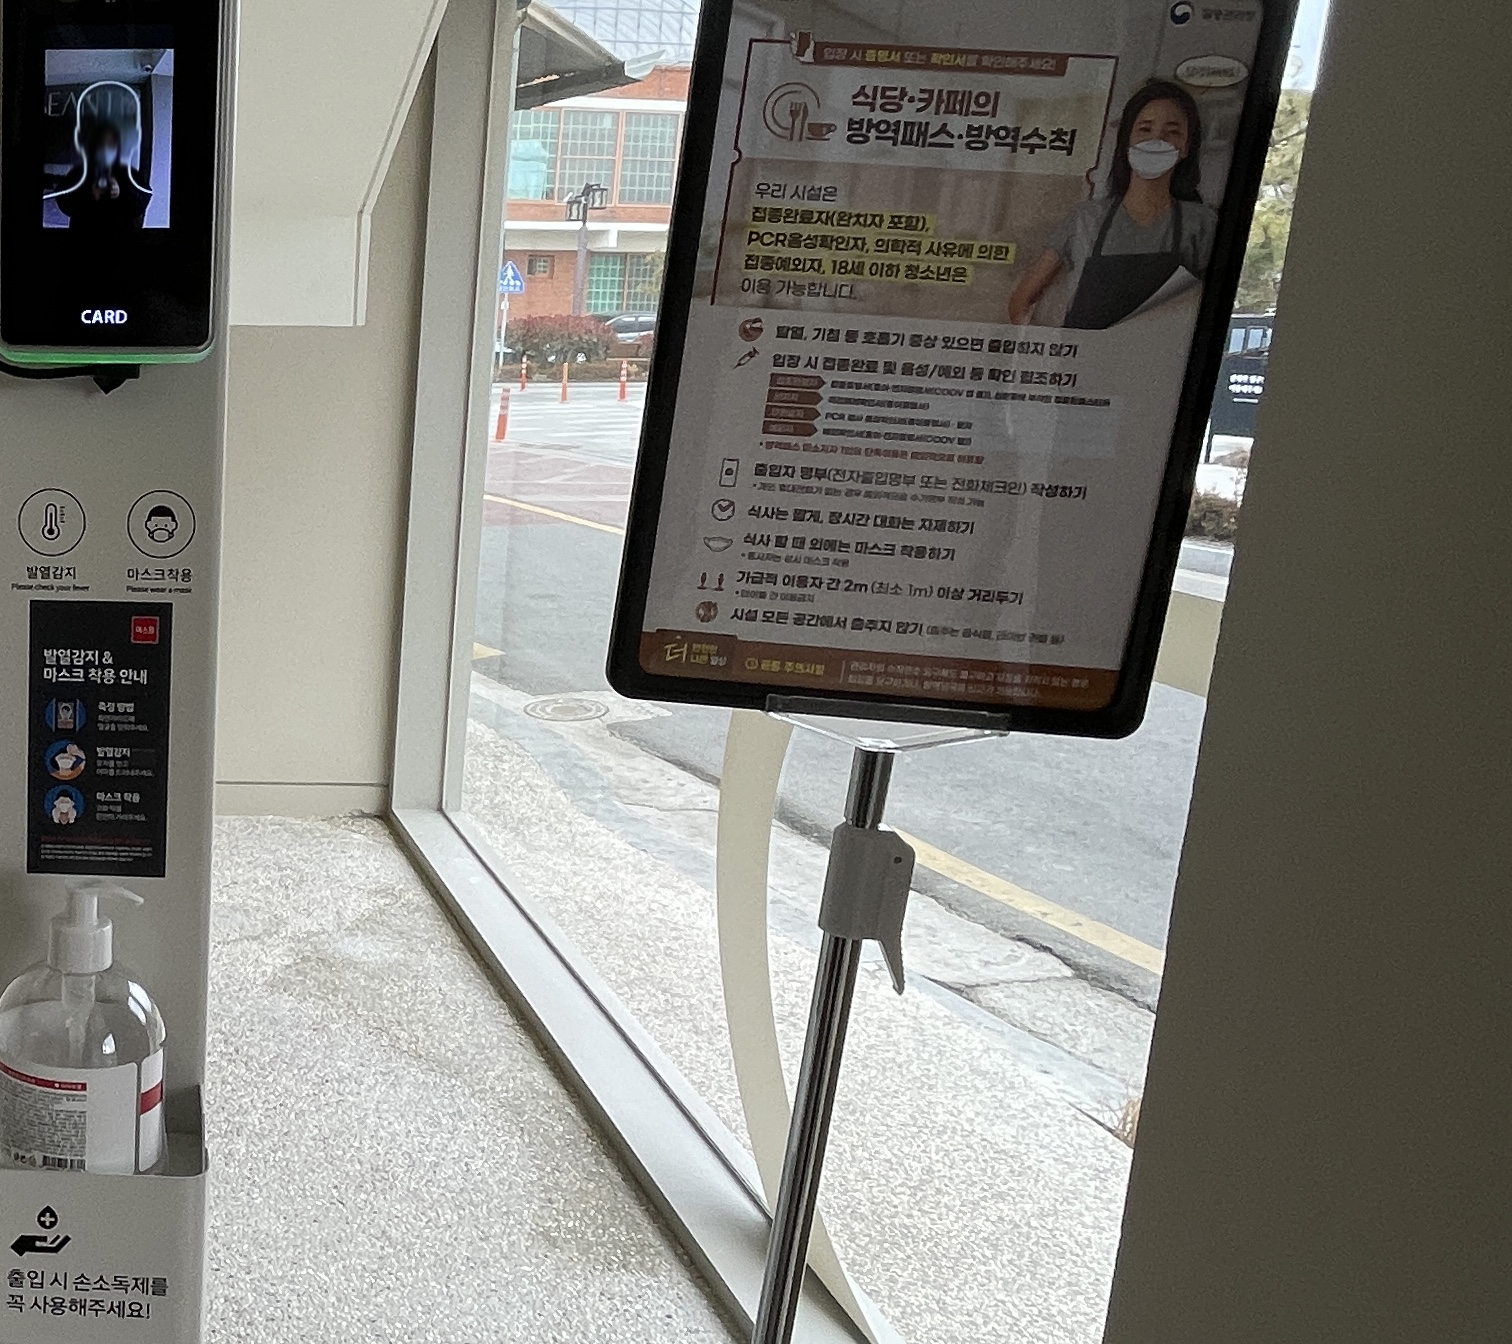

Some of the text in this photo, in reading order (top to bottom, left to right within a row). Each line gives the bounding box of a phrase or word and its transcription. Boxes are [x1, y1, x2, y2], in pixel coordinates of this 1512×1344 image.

[851, 47, 863, 62] 시
[851, 84, 1000, 118] 식당·카페의
[846, 118, 1077, 155] 방역패스·방역수칙
[755, 182, 838, 202] 우리 시설은
[925, 241, 975, 259] 사유에
[978, 244, 1010, 261] 의한
[831, 258, 865, 277] 18세
[869, 261, 901, 279] 이하
[905, 263, 968, 283] 청소년은
[741, 277, 858, 300] 이용 가능합니다.
[80, 308, 128, 325] CARD
[804, 355, 819, 370] 시
[919, 474, 948, 490] 또는
[747, 505, 789, 521] 식사는
[743, 532, 771, 548] 식사
[854, 540, 896, 557] 마스크
[26, 565, 76, 581] 발열감지
[127, 567, 193, 583] 마스크착용
[736, 570, 778, 587] 가급적
[782, 573, 823, 590] 이용자
[825, 576, 841, 591] 간
[843, 578, 869, 594] 2m
[907, 583, 934, 598] 1m)
[937, 585, 965, 601] 이상
[967, 588, 1024, 606] 거리두기
[730, 607, 758, 622] 시설
[761, 609, 789, 625] 모든
[43, 648, 113, 666] 발열감지 &
[43, 667, 148, 685] 마스크 착용 안내
[96, 746, 131, 758] 발열감지
[96, 791, 122, 803] 마스크
[6, 1268, 168, 1297] 출입 시 손소독제를
[6, 1293, 151, 1320] 꼭 사용해주세요!
